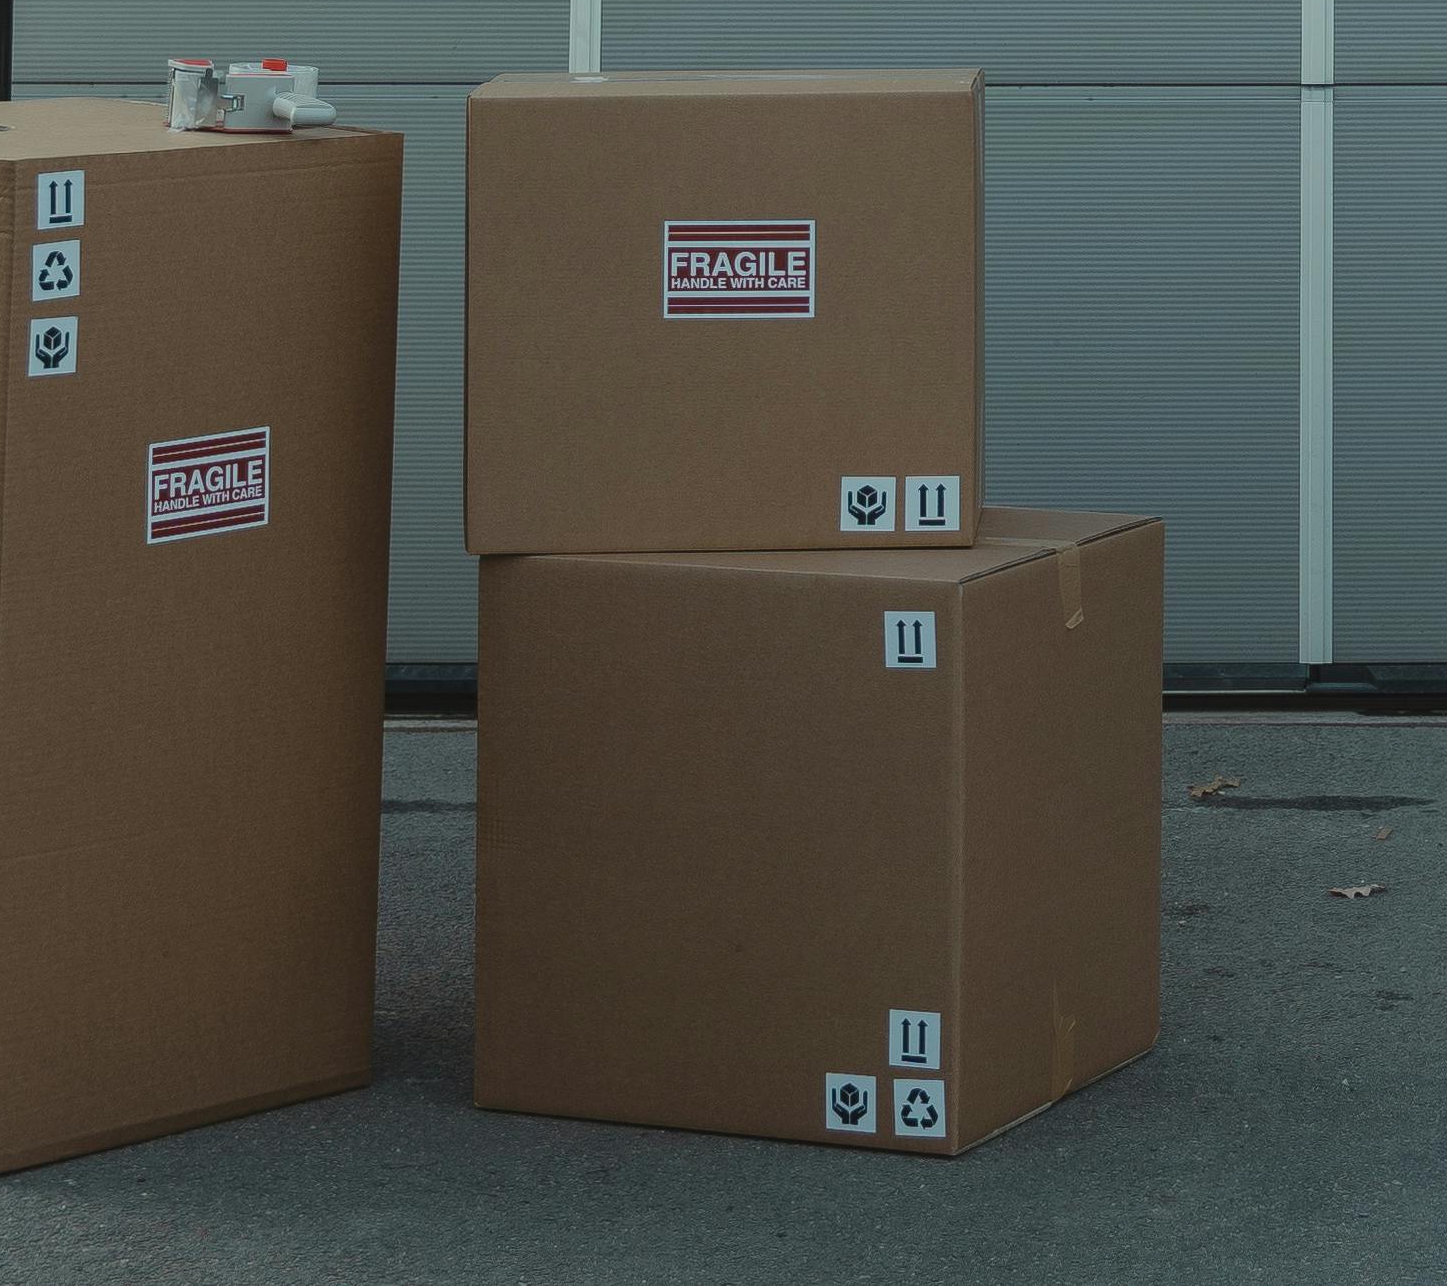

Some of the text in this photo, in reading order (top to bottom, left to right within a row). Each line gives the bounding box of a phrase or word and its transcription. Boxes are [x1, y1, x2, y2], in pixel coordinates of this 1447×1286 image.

[670, 251, 807, 277] FRAGILE
[671, 277, 806, 289] HANDLE WITH CARE
[154, 459, 263, 500] FRAGILE
[153, 485, 262, 513] HANDLE WITH CARE
